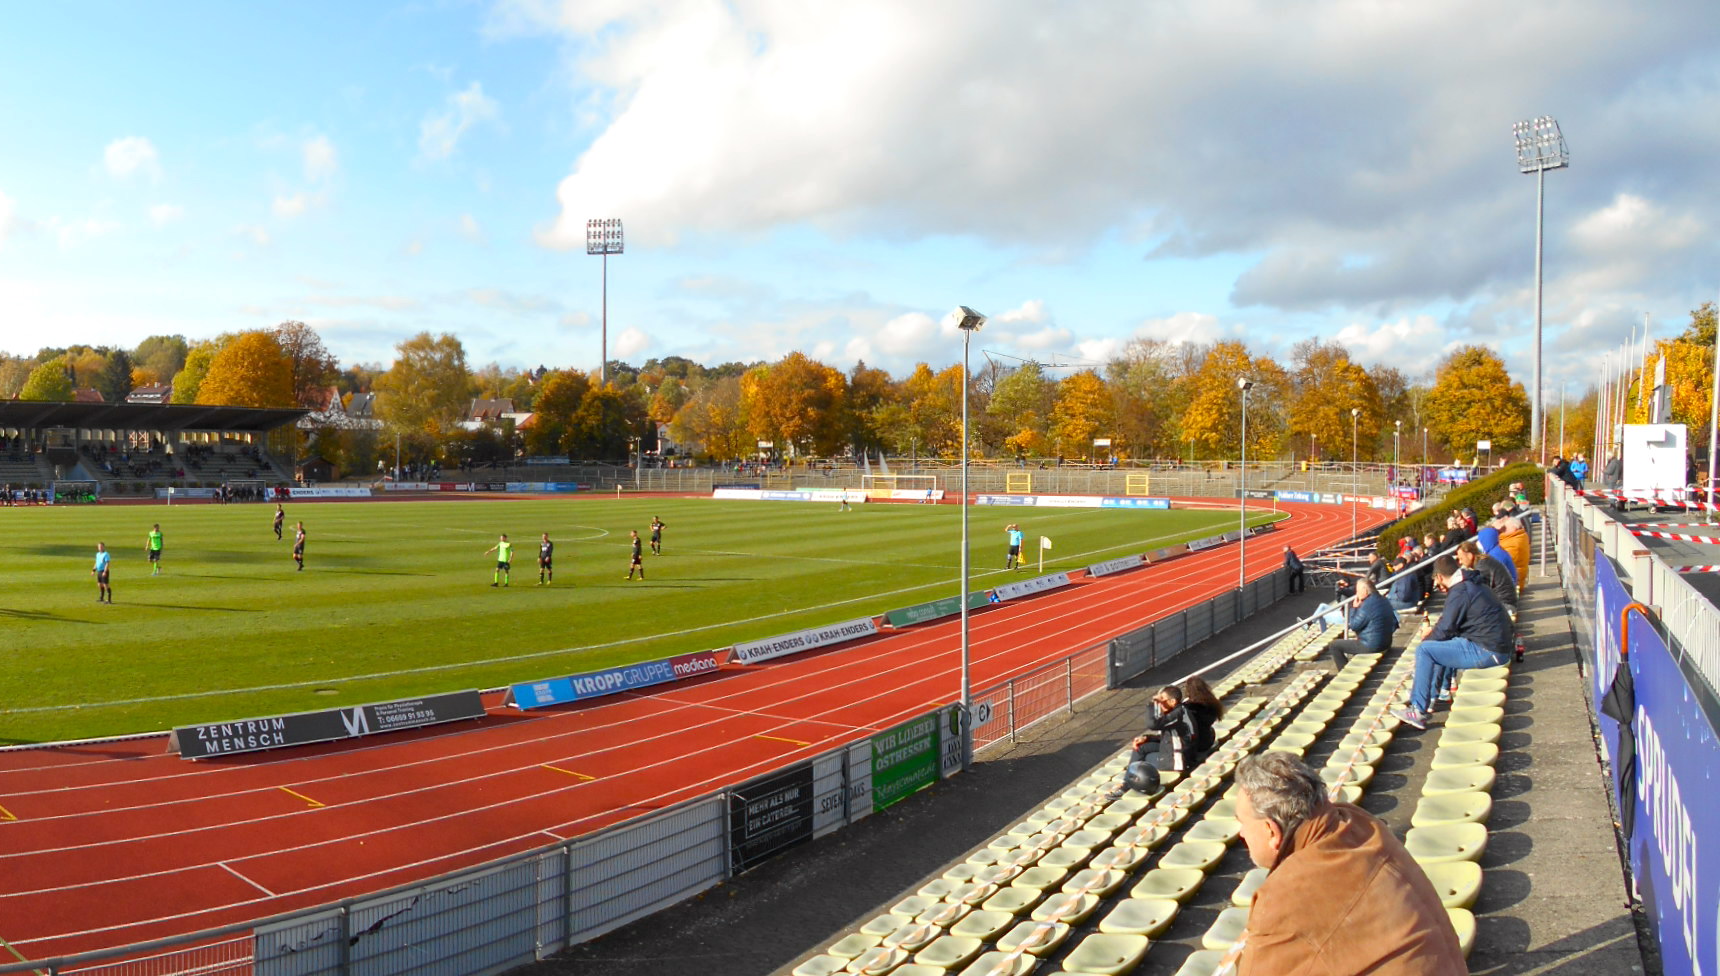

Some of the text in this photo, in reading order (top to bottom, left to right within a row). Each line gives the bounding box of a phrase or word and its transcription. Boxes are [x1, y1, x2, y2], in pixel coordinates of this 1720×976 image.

[196, 718, 285, 740] ZENTRUM
[205, 732, 285, 753] MENSCH
[770, 793, 783, 808] ALS
[1635, 704, 1703, 976] SPRUDEL
